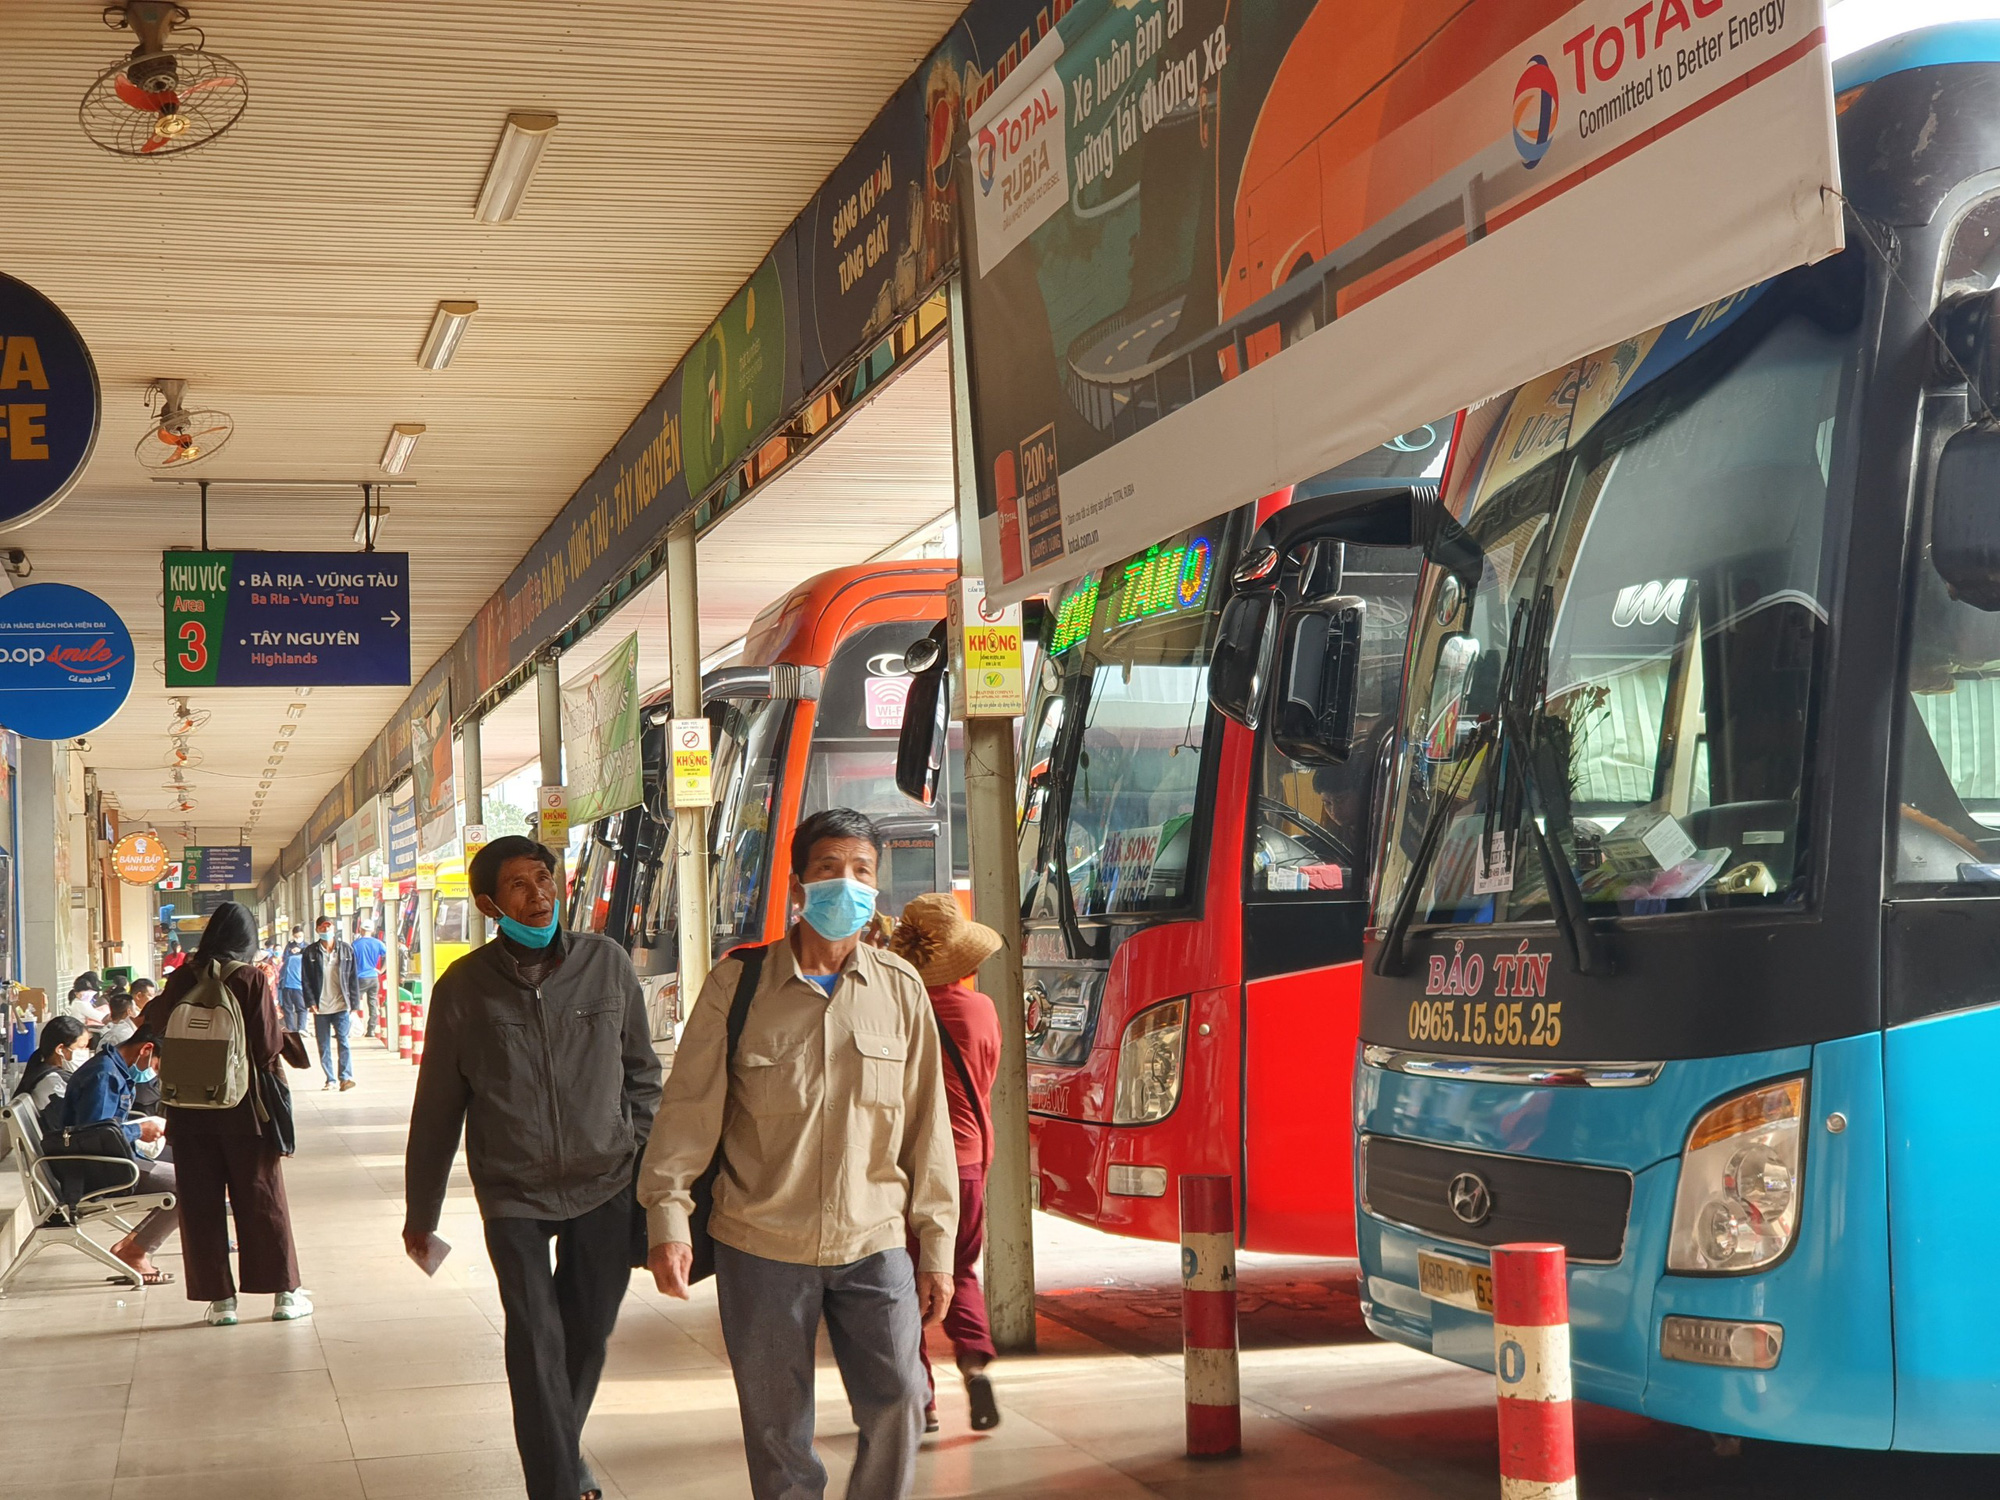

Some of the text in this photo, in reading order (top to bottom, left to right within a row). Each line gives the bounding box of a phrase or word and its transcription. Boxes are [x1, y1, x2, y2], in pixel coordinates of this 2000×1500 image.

[1072, 75, 1092, 128] Xe
[1095, 38, 1131, 105] luôn
[1135, 9, 1161, 68] êm
[1579, 0, 1787, 138] Committed to Better Energy
[996, 88, 1058, 162] TOTAL
[1075, 126, 1112, 190] vững
[1117, 91, 1138, 155] lái
[1139, 54, 1197, 133] đường
[1203, 24, 1227, 82] xa
[832, 199, 858, 249] SÁNG
[866, 213, 890, 268] GIÂY
[0, 336, 50, 390] A
[614, 463, 634, 536] TÂY
[634, 409, 681, 516] NGUYÊN
[170, 562, 227, 598] KHU VỰC
[251, 571, 273, 587] BÀ
[277, 574, 304, 590] RỊA
[316, 571, 364, 587] VŨNG
[367, 571, 398, 587] TÀU
[173, 596, 205, 612] Area
[251, 594, 267, 605] Ba
[300, 593, 334, 607] Vung
[338, 594, 359, 605] Tau
[13, 621, 34, 629] HÀNG
[251, 630, 359, 645] TÂY NGUYÊN
[968, 628, 1017, 653] KHÔNG
[47, 638, 114, 664] smile
[178, 621, 208, 672] 3
[251, 653, 318, 666] Highlands
[676, 752, 708, 767] KHÔNG
[119, 854, 142, 864] BÁNH
[1125, 832, 1158, 862] SONG
[187, 865, 198, 880] 2
[1425, 938, 1552, 997] BẢO TÍN
[1408, 1000, 1562, 1047] 0965.15.95.25
[1500, 1341, 1525, 1384] 0
